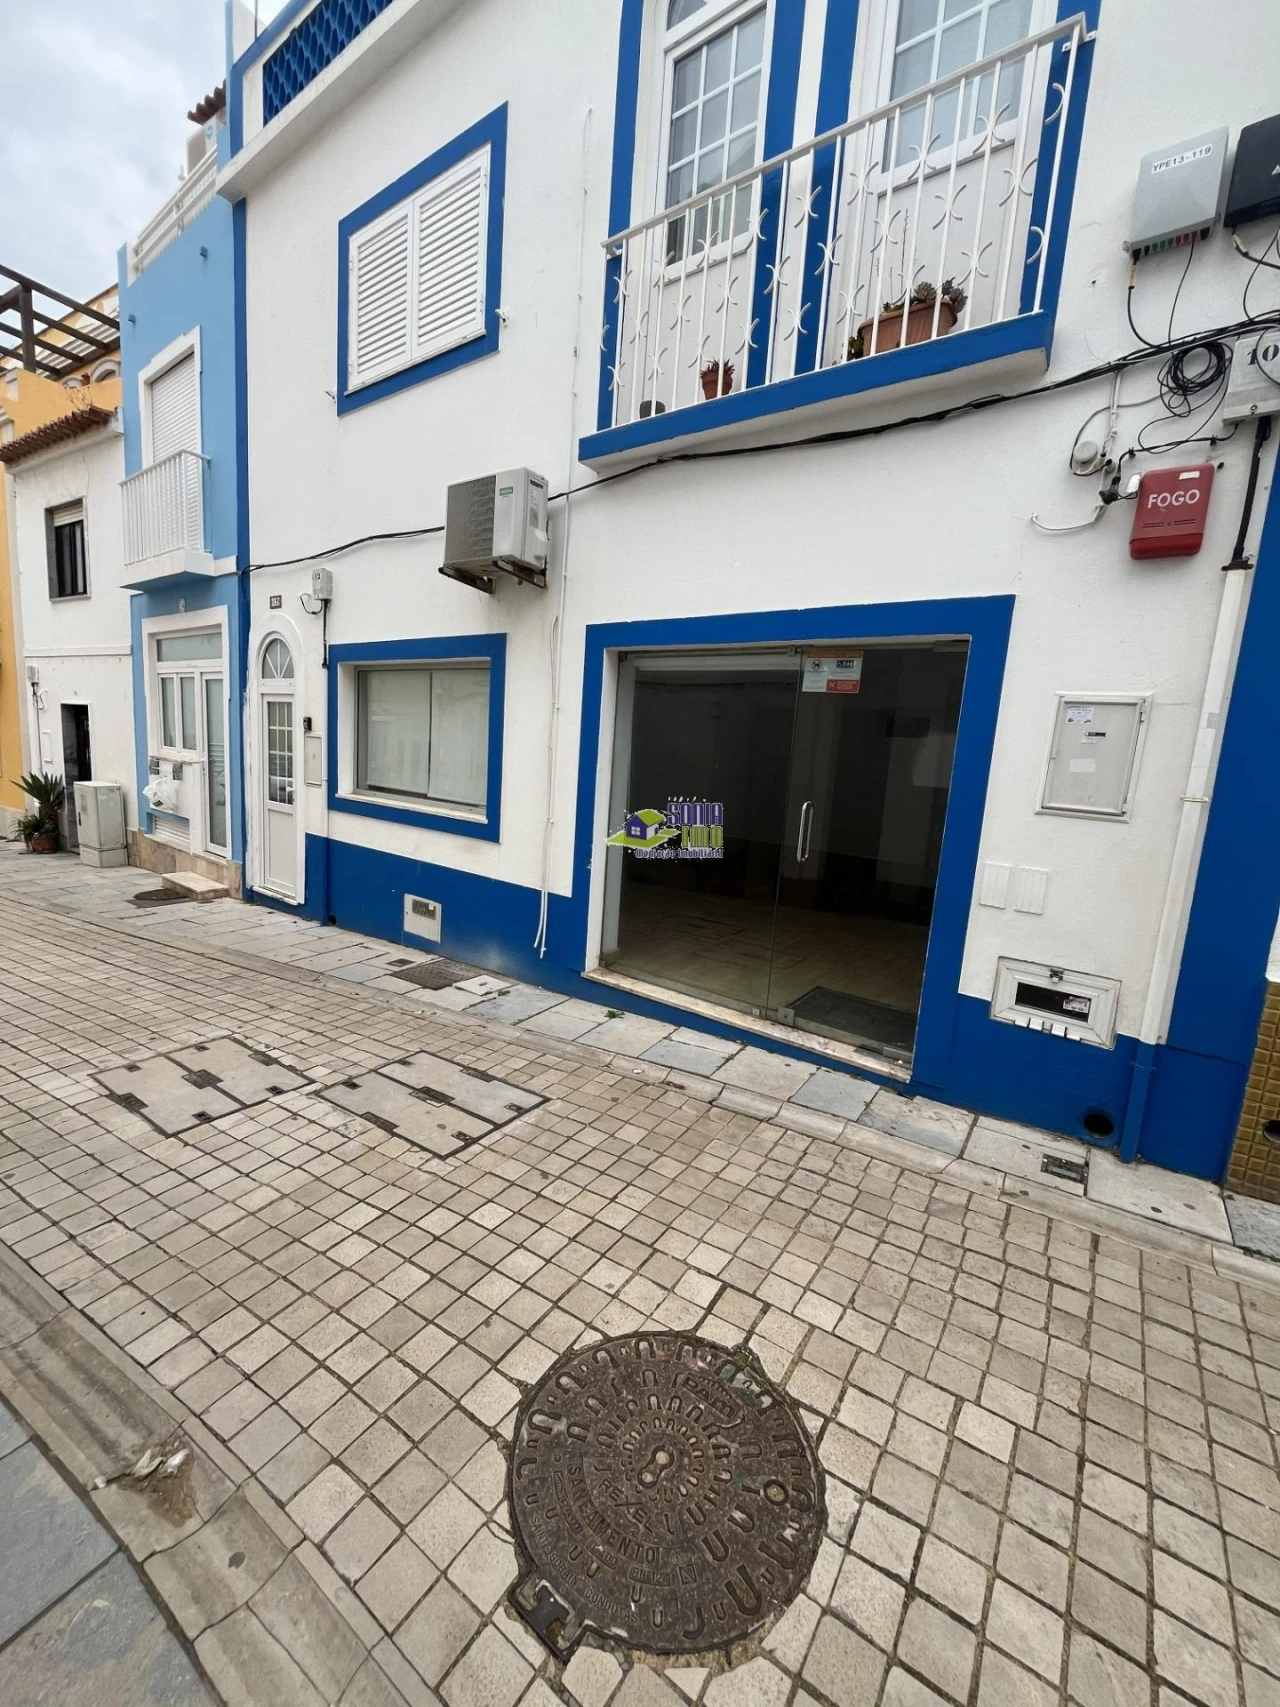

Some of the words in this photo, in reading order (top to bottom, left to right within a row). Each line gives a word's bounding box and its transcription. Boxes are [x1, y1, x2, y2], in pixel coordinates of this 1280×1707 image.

[1153, 146, 1211, 171] YPE13-119
[1147, 489, 1200, 509] FOGO
[568, 1465, 656, 1564] SANEAMENTO
[598, 1478, 653, 1534] REXEL
